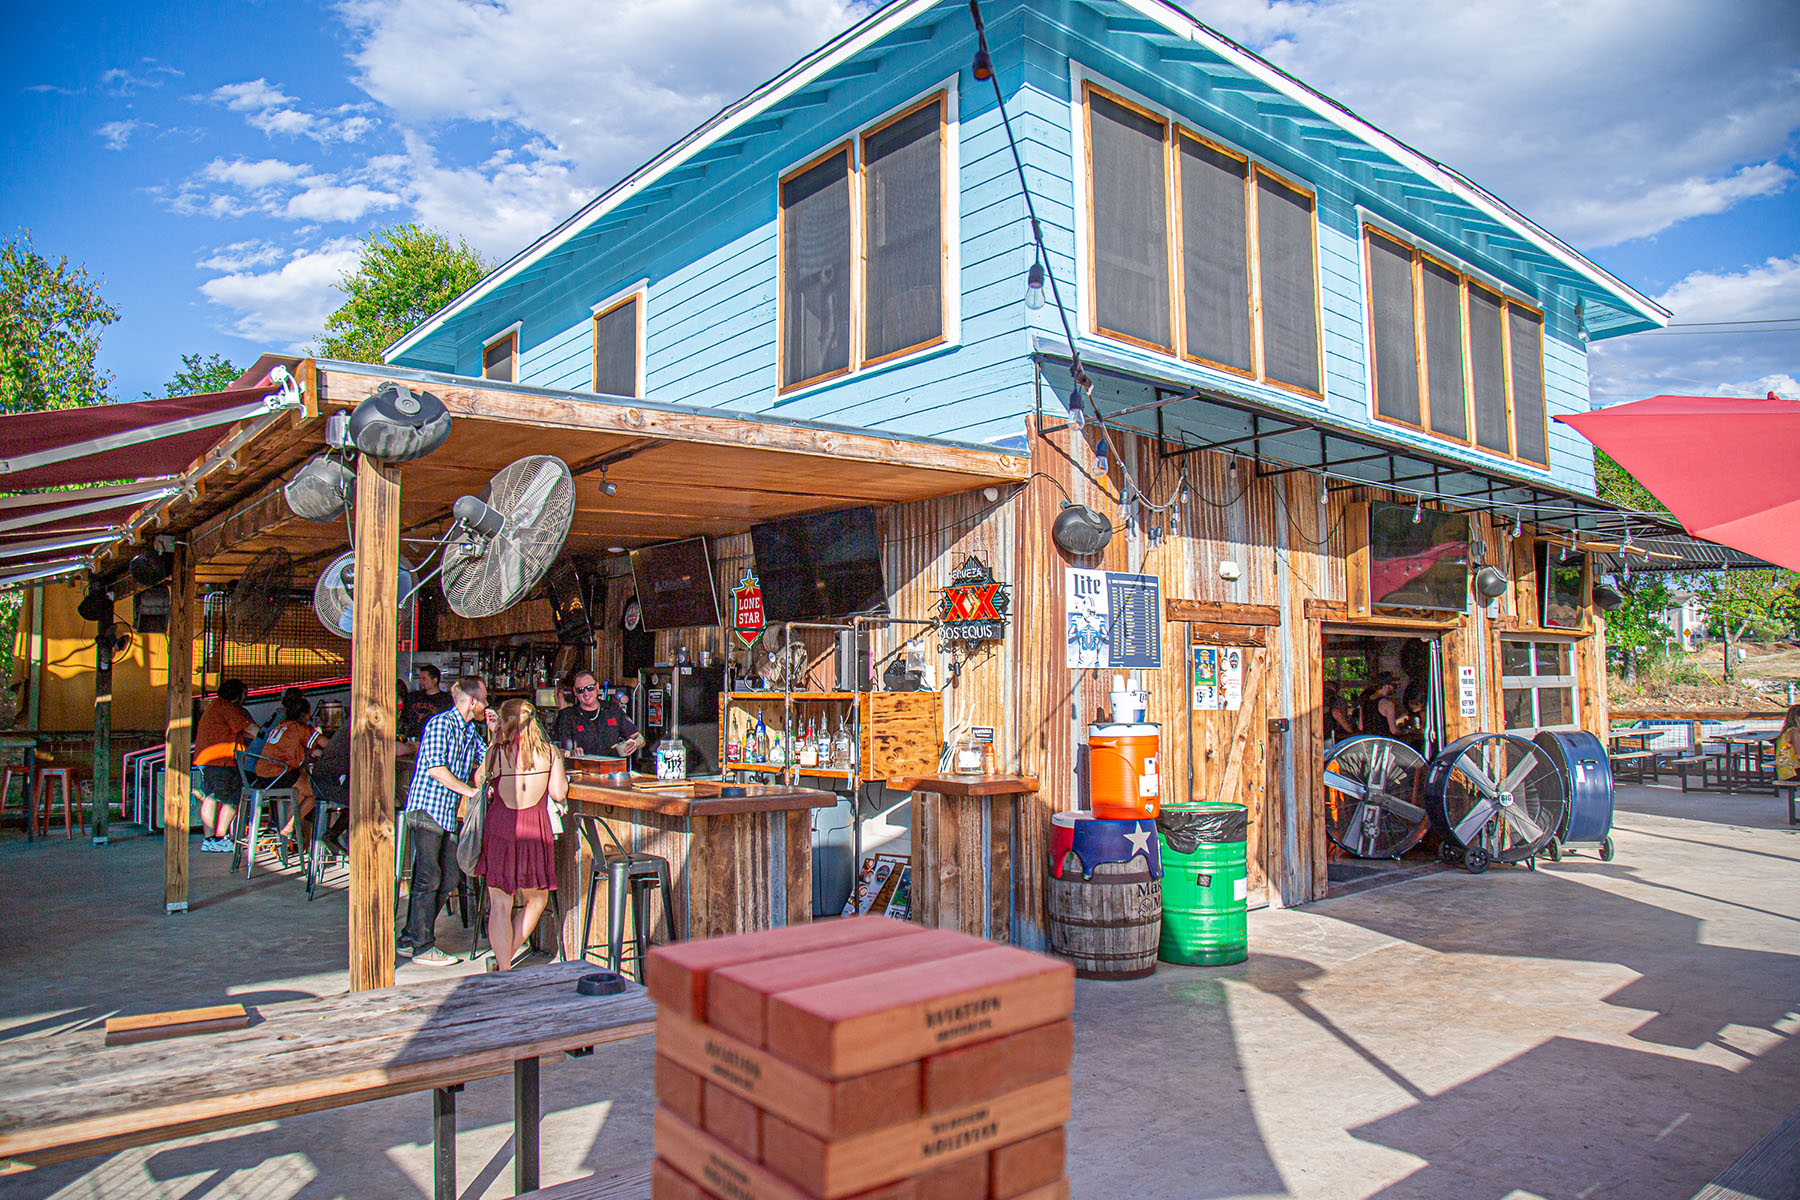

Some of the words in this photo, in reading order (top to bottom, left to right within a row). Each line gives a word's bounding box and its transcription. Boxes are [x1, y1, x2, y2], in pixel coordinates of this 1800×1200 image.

[1073, 573, 1101, 599] Lite
[739, 597, 761, 610] LONE
[939, 583, 1001, 622] XX
[738, 611, 760, 625] STAR
[939, 626, 960, 640] DOS
[961, 624, 993, 639] EQUIS
[1500, 794, 1513, 802] BIG
[926, 995, 1001, 1028] AVIATION
